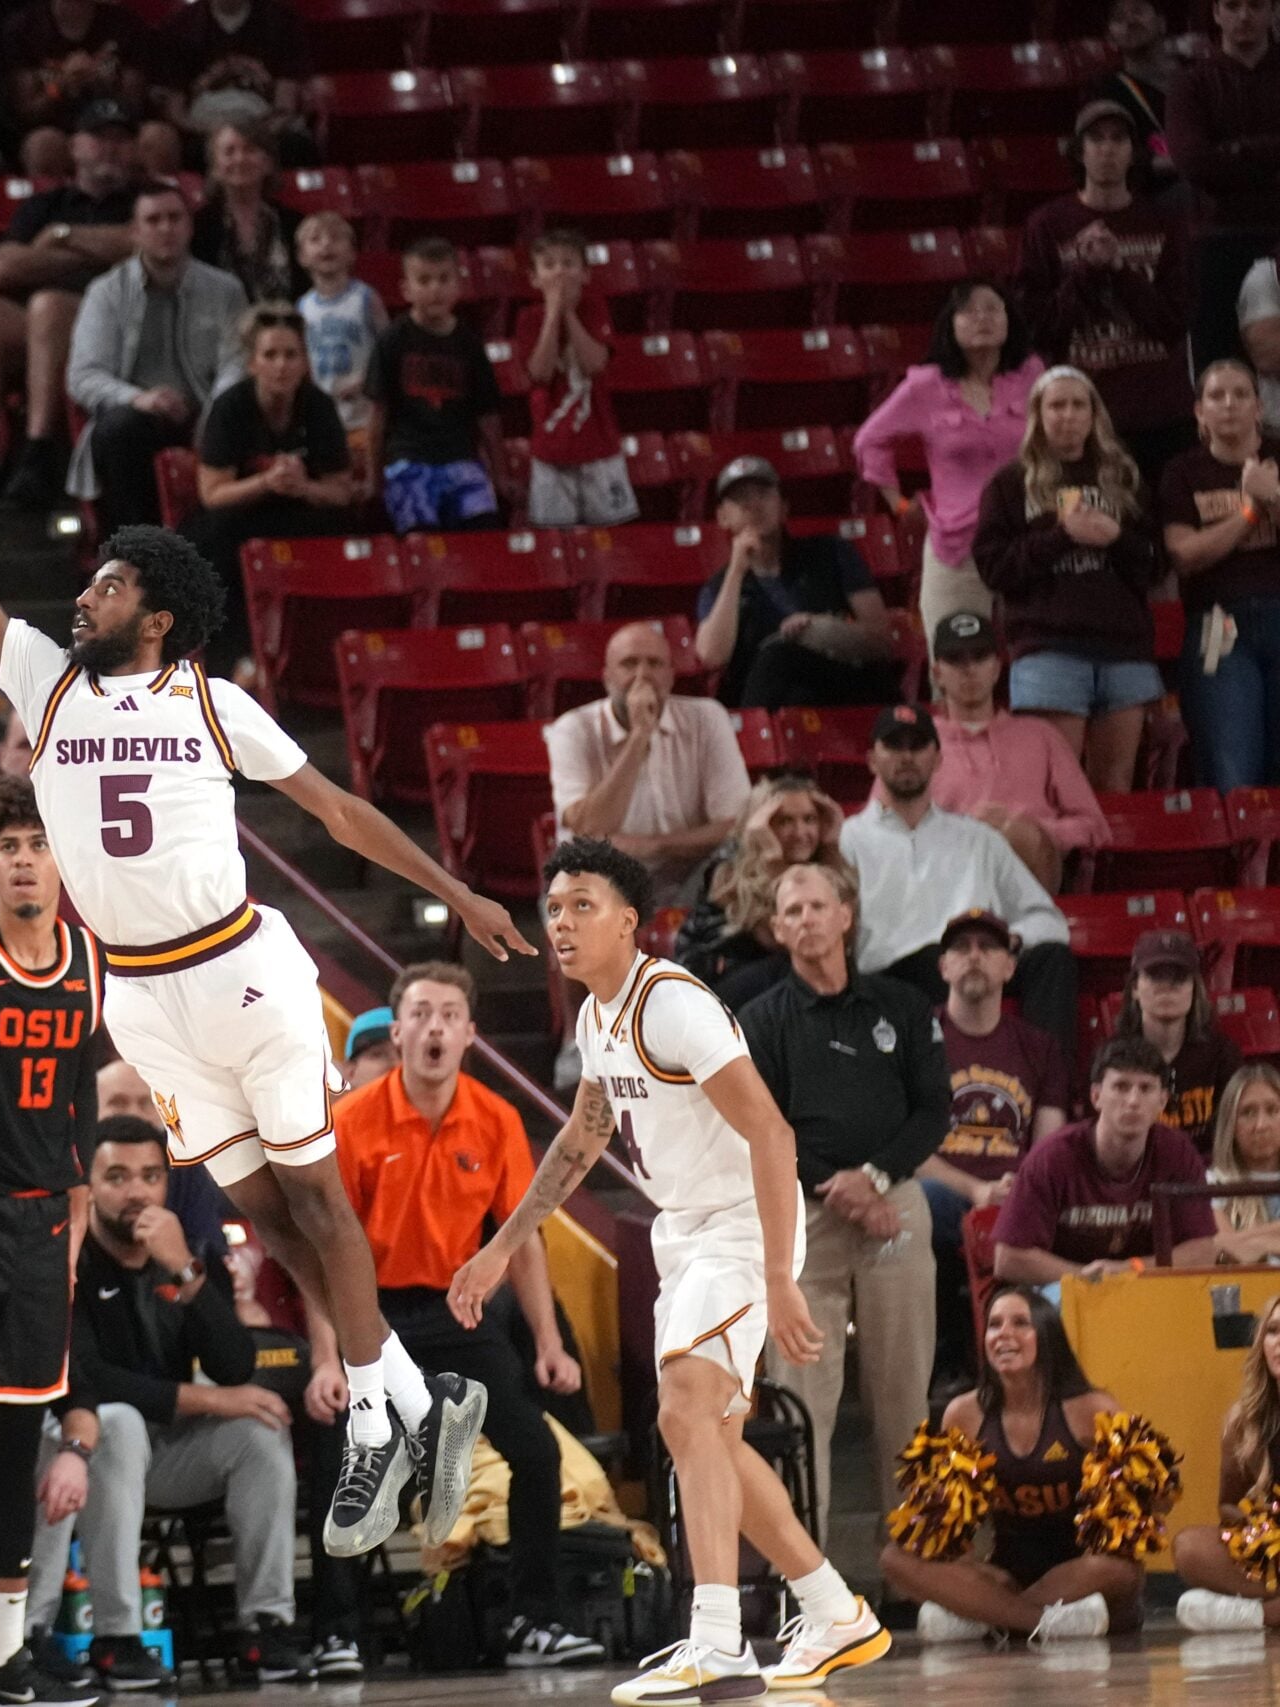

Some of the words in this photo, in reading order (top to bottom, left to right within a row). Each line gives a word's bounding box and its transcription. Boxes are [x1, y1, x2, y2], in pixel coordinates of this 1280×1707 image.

[56, 737, 105, 765] SUN
[112, 737, 202, 763] DEVILS
[99, 773, 154, 858] 5
[17, 1057, 58, 1110] 13
